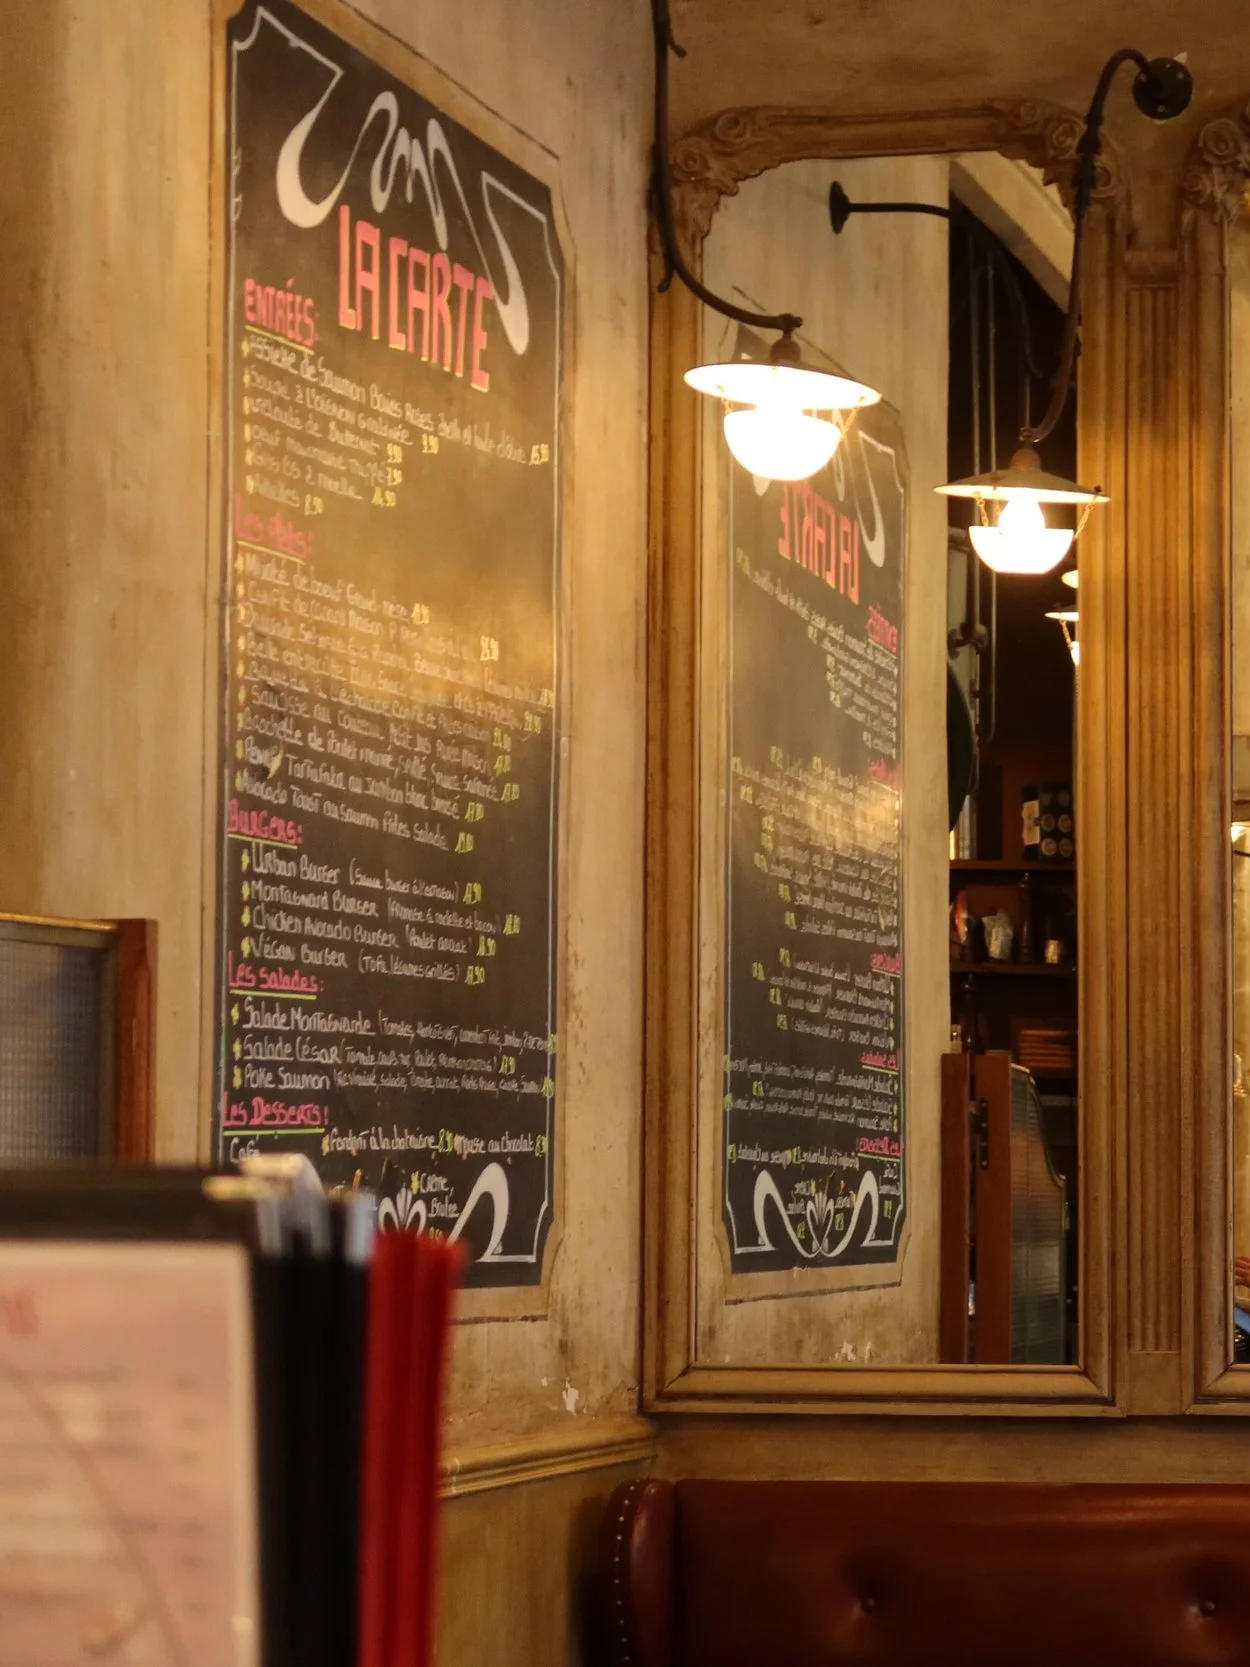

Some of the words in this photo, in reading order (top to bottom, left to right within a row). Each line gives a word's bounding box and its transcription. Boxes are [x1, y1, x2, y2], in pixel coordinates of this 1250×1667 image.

[339, 205, 381, 339] LA
[389, 239, 494, 393] CARTE
[300, 350, 317, 382] de
[317, 356, 366, 405] Saumon
[308, 725, 324, 752] de
[300, 854, 340, 884] Burger
[227, 952, 255, 988] Les
[301, 943, 348, 968] Burger
[242, 996, 290, 1031] Salade
[243, 1034, 294, 1061] Salade
[278, 1067, 330, 1090] Saumon
[223, 1094, 248, 1127] Les
